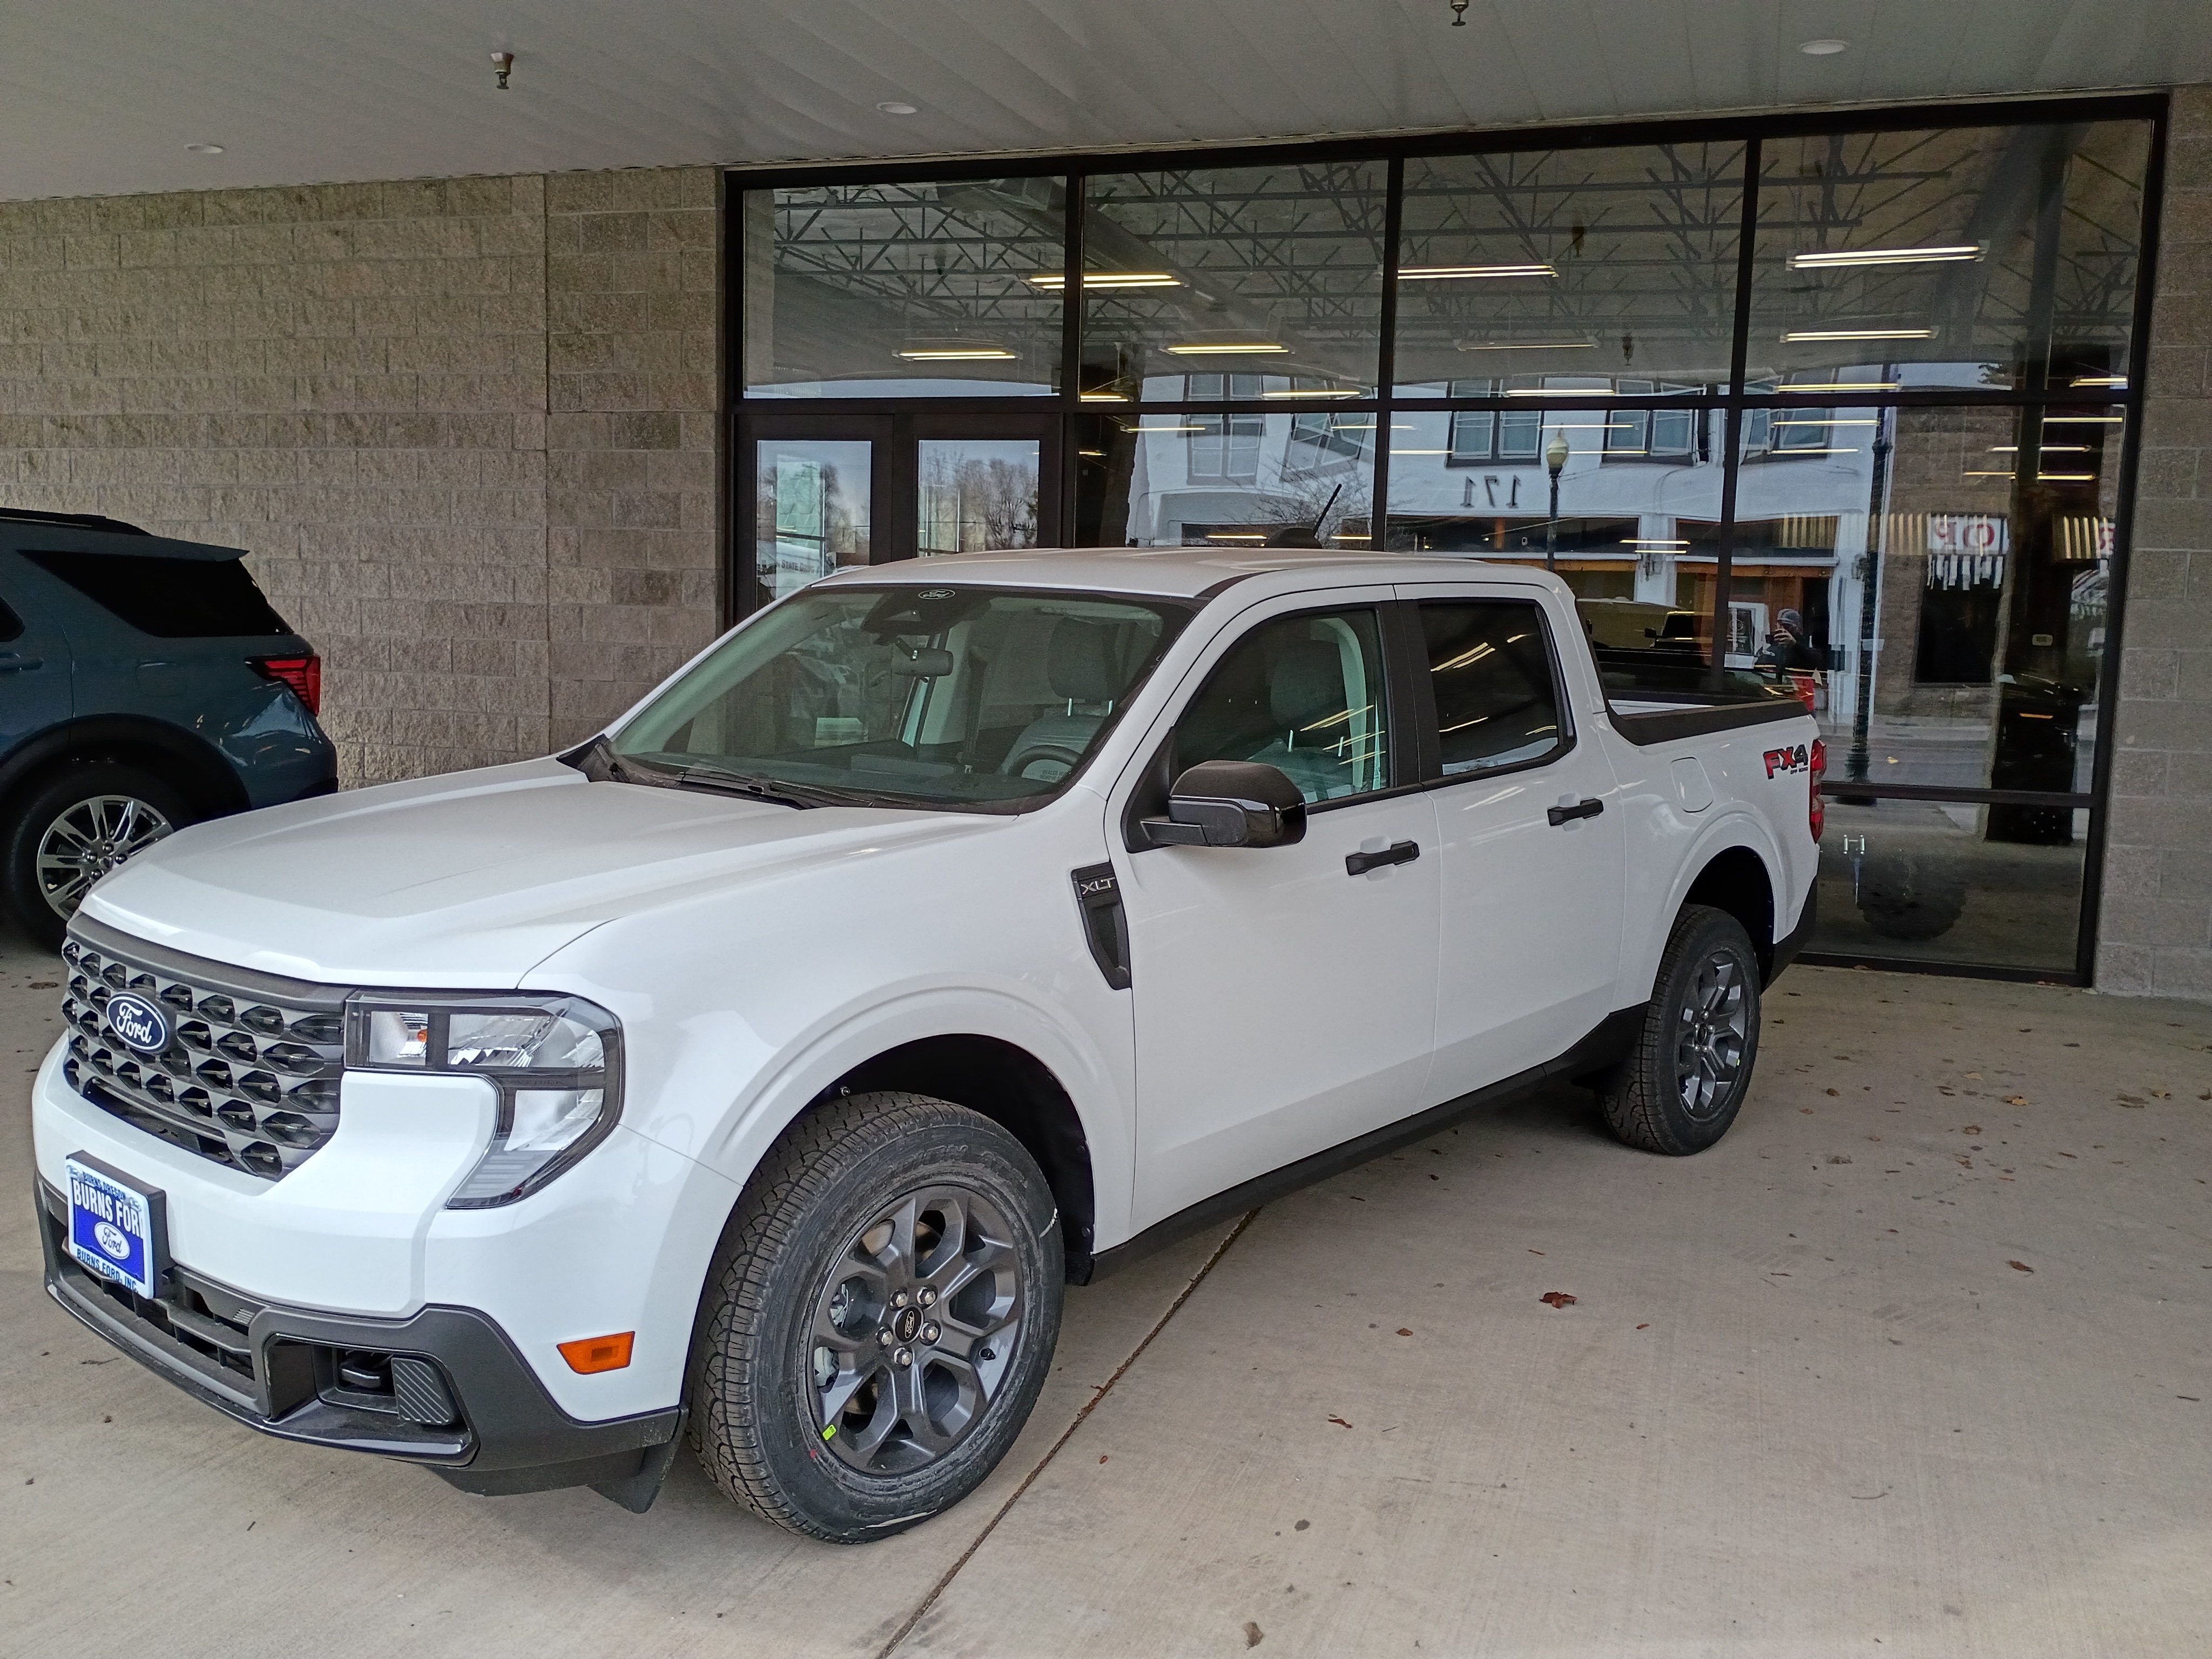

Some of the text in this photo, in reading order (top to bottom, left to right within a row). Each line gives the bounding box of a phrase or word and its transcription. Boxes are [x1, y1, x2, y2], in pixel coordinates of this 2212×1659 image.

[1763, 744, 1808, 780] FX4
[1081, 876, 1116, 895] XLT
[117, 1002, 152, 1043] Ford
[72, 1178, 113, 1222] BURNS
[103, 1226, 122, 1253] Ford
[77, 1248, 100, 1269] BURNS
